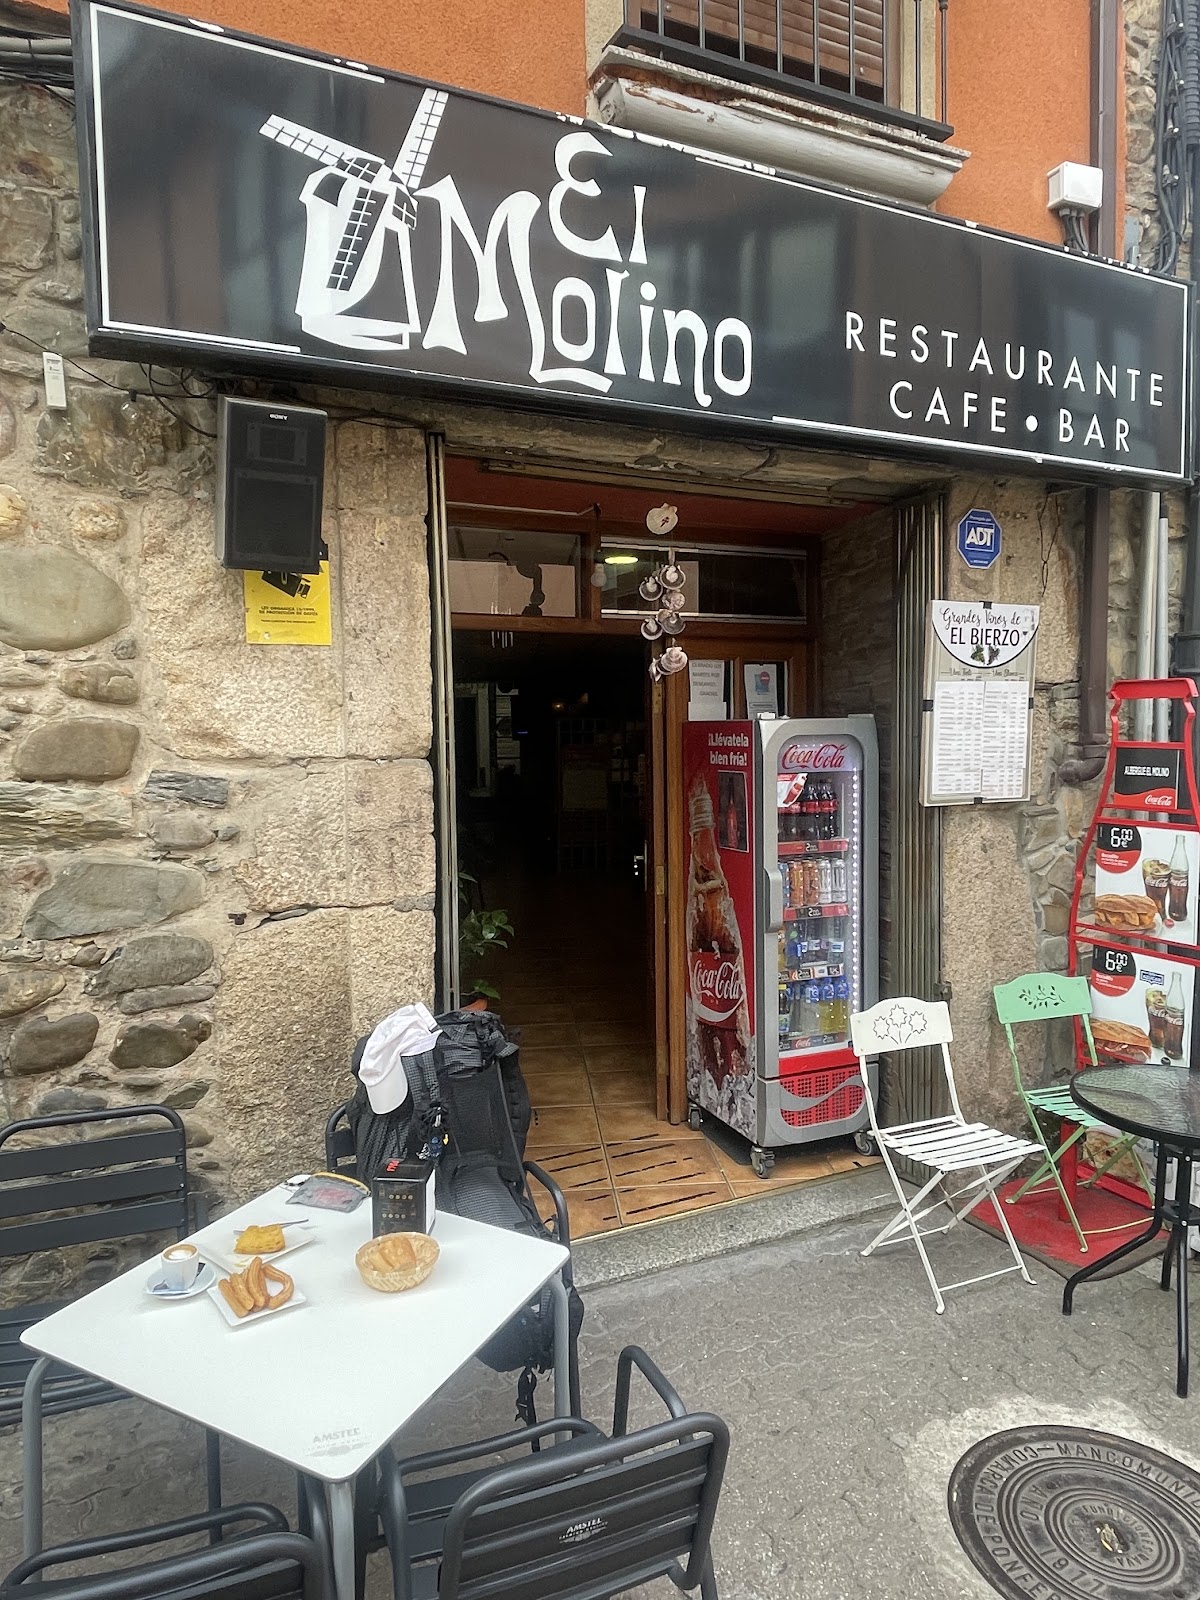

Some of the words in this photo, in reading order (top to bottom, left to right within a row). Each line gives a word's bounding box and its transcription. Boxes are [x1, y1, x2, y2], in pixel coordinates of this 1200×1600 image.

[548, 131, 648, 265] El
[412, 174, 752, 407] Molino
[845, 310, 1164, 408] RESTAURANTE
[269, 413, 288, 421] SONY
[889, 380, 1007, 434] CAFE
[1058, 407, 1131, 453] BAR
[965, 526, 995, 547] ADT
[940, 607, 981, 630] Grandes
[984, 609, 1007, 628] Vinos
[1010, 611, 1021, 626] de
[950, 627, 966, 645] EL
[970, 627, 1020, 647] BIERZO
[707, 732, 749, 748] ¡Llévatela
[709, 751, 729, 765] bien
[729, 751, 748, 767] fría!
[781, 743, 850, 770] Coca-Cola
[1144, 793, 1173, 806] Coca-Cola
[694, 960, 742, 1000] Coca-Cola
[312, 1427, 361, 1443] AMSTEL
[974, 1445, 1039, 1496] COMARCA
[974, 1502, 997, 1524] DE
[566, 1517, 602, 1534] AMSTEL
